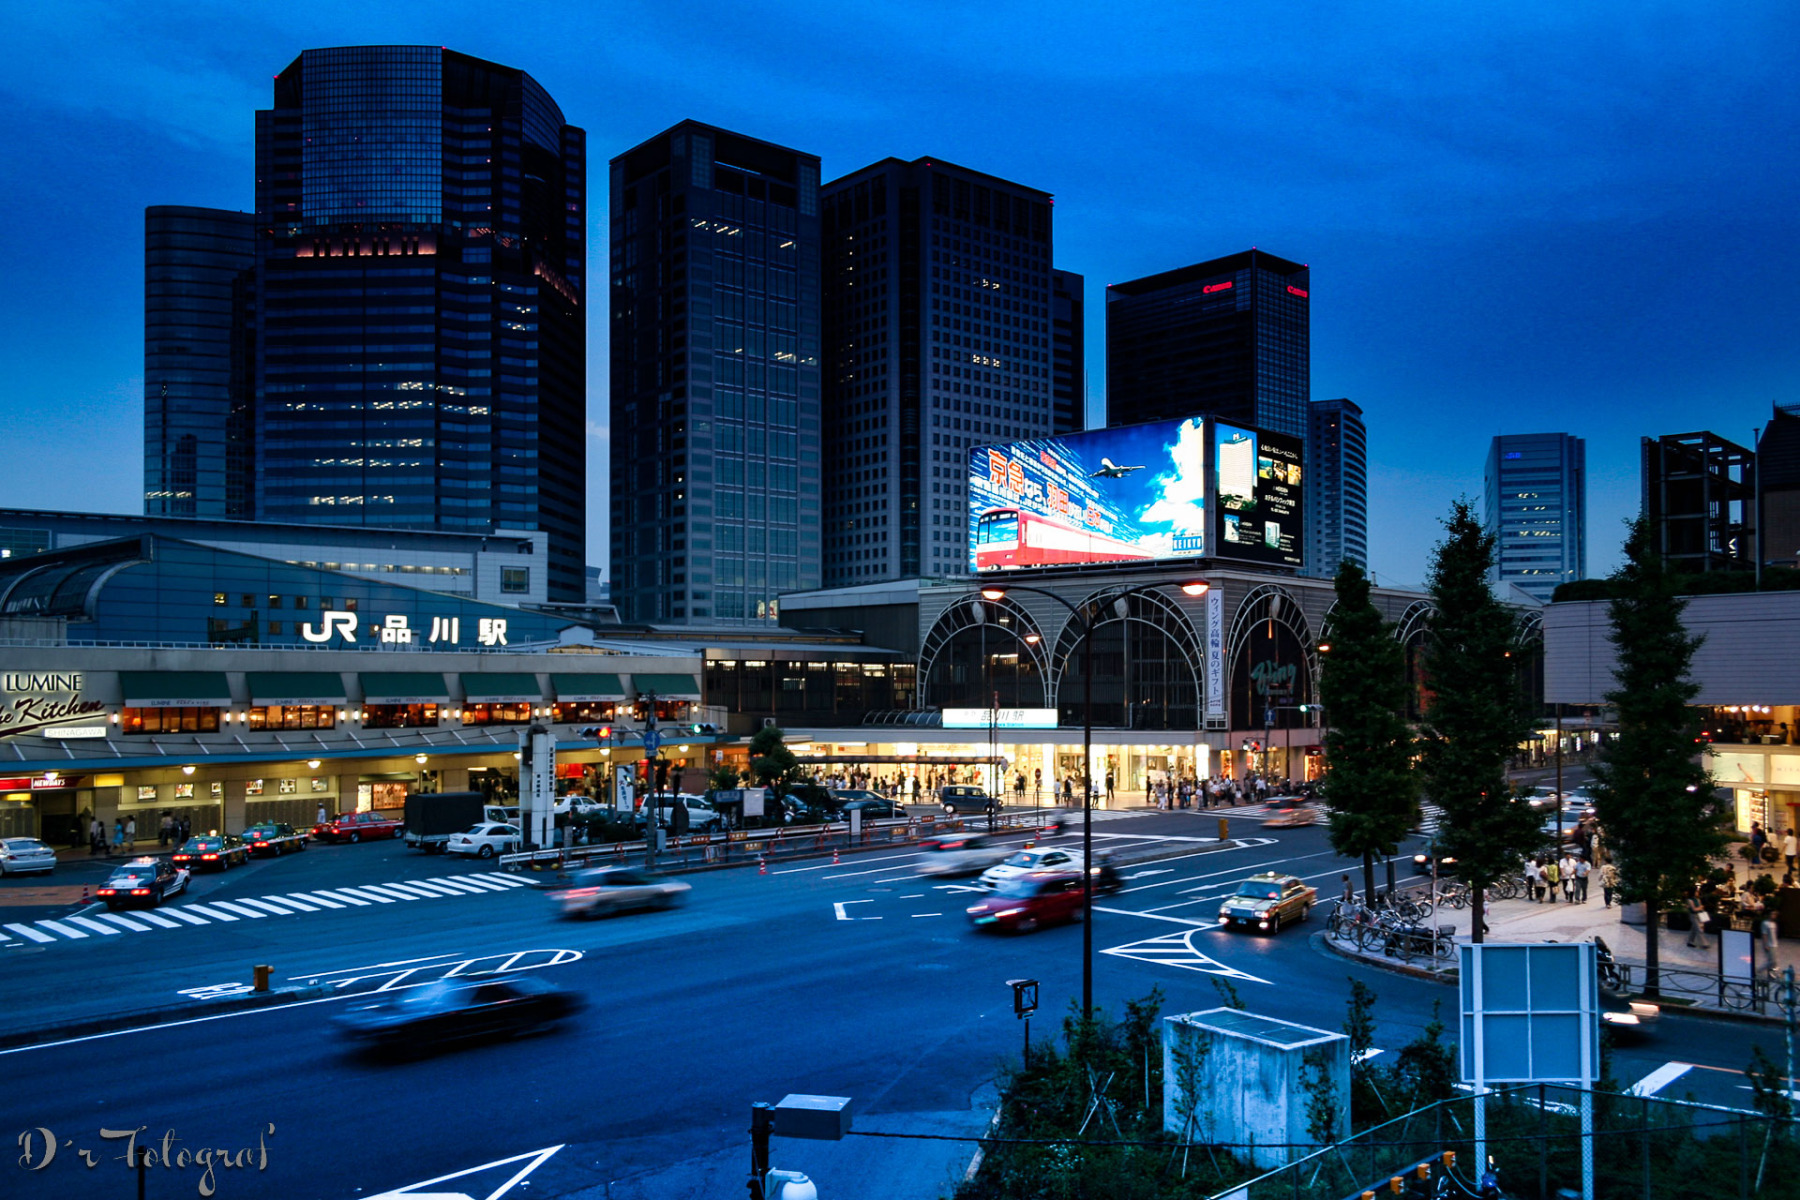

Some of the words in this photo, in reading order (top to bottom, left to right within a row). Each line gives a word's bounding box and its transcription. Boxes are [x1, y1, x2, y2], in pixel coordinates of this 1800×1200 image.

[302, 611, 358, 643] JR
[381, 615, 508, 646] 品川駅
[6, 674, 82, 691] LUMINE
[15, 694, 105, 723] Kitchen
[47, 728, 103, 736] SHINAGAWA
